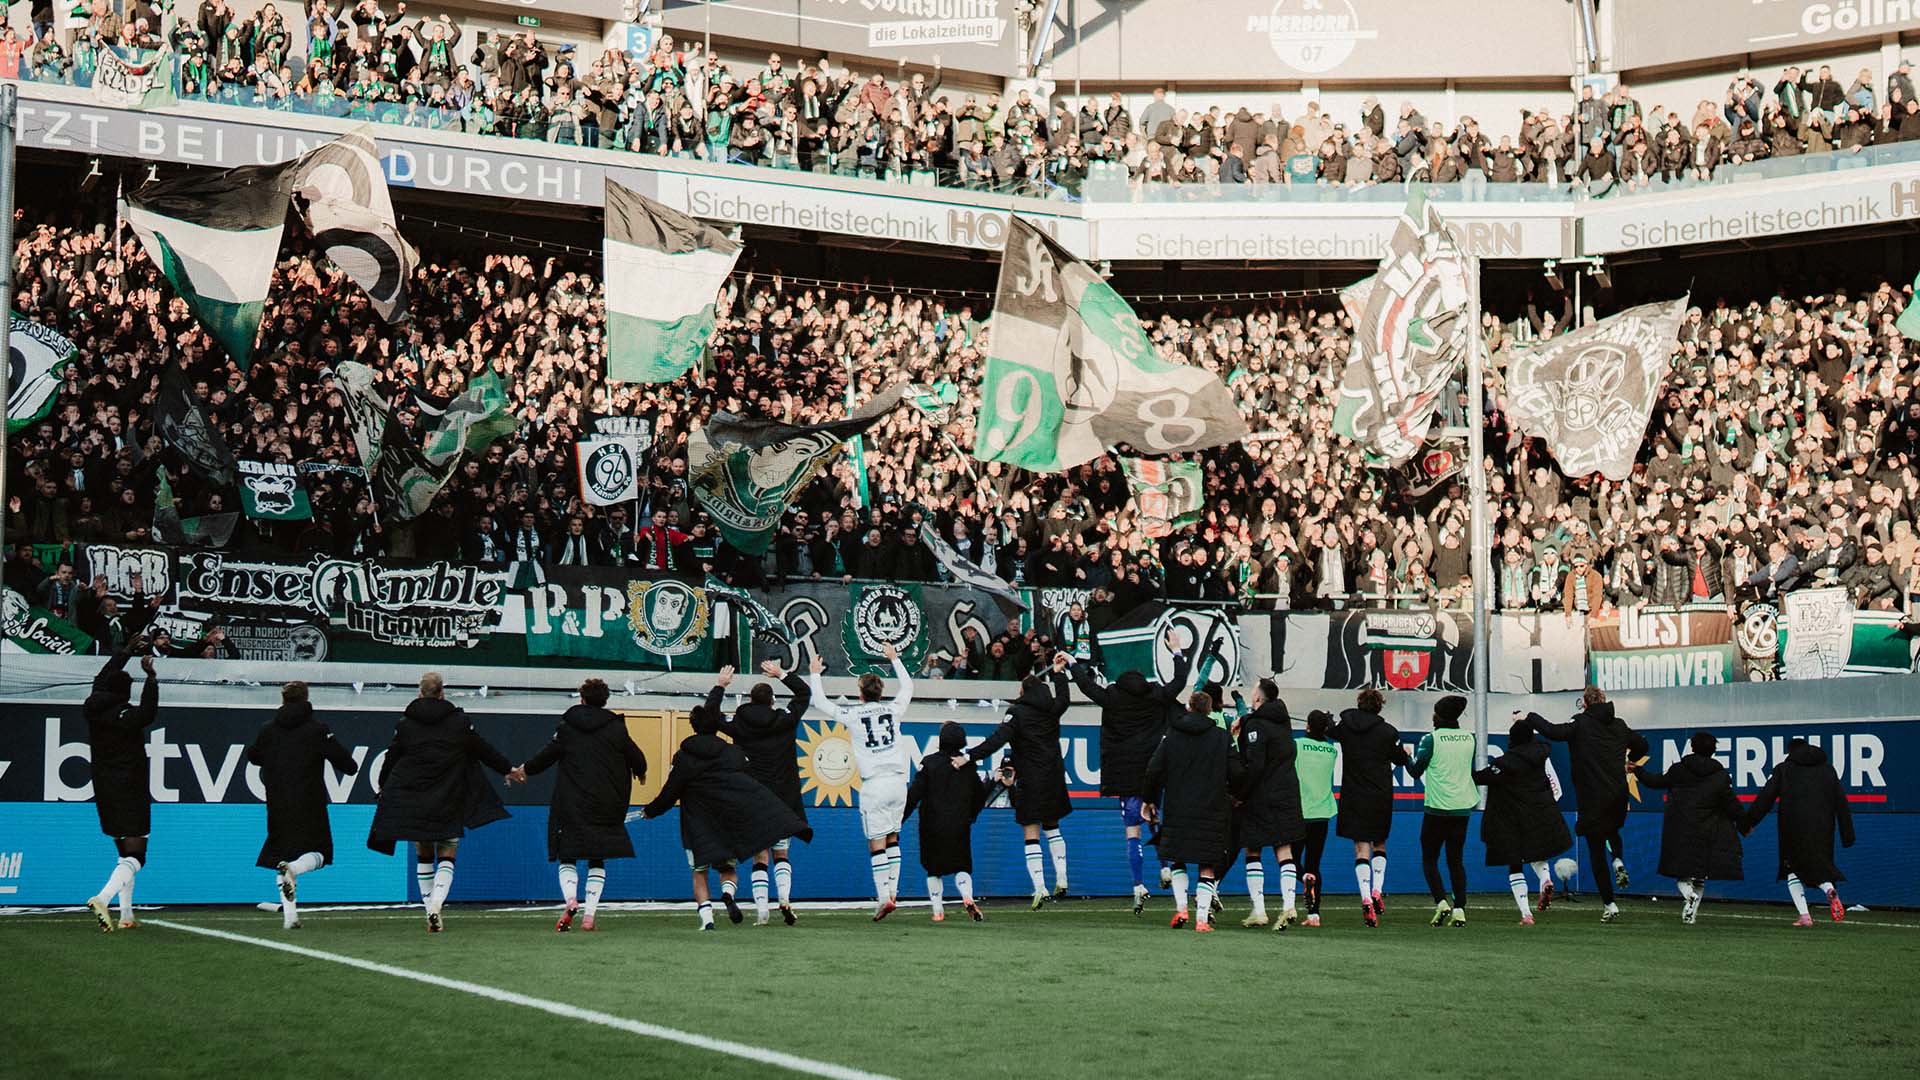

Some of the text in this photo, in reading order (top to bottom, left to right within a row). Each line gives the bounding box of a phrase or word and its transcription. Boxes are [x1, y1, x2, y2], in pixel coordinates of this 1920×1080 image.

[632, 32, 647, 54] 3
[875, 22, 993, 41] die Lokalzeitung
[1302, 46, 1323, 62] 07
[15, 107, 109, 149] TZT
[138, 119, 224, 162] BEI
[389, 148, 582, 200] DURCH!
[691, 189, 938, 240] Sicherheitstechnik
[1620, 196, 1881, 248] Sicherheitstechnik
[1136, 232, 1391, 258] Sicherheitstechnik
[986, 370, 1206, 452] 9 8
[597, 445, 625, 457] HSV
[601, 454, 624, 489] 96
[592, 483, 624, 500] Hannover
[885, 590, 904, 600] ALS
[1743, 603, 1780, 618] SEKTION
[22, 616, 77, 656] Society
[1618, 604, 1690, 648] WEST
[1747, 613, 1778, 650] 96
[861, 714, 896, 748] 13
[0, 852, 23, 878] bH
